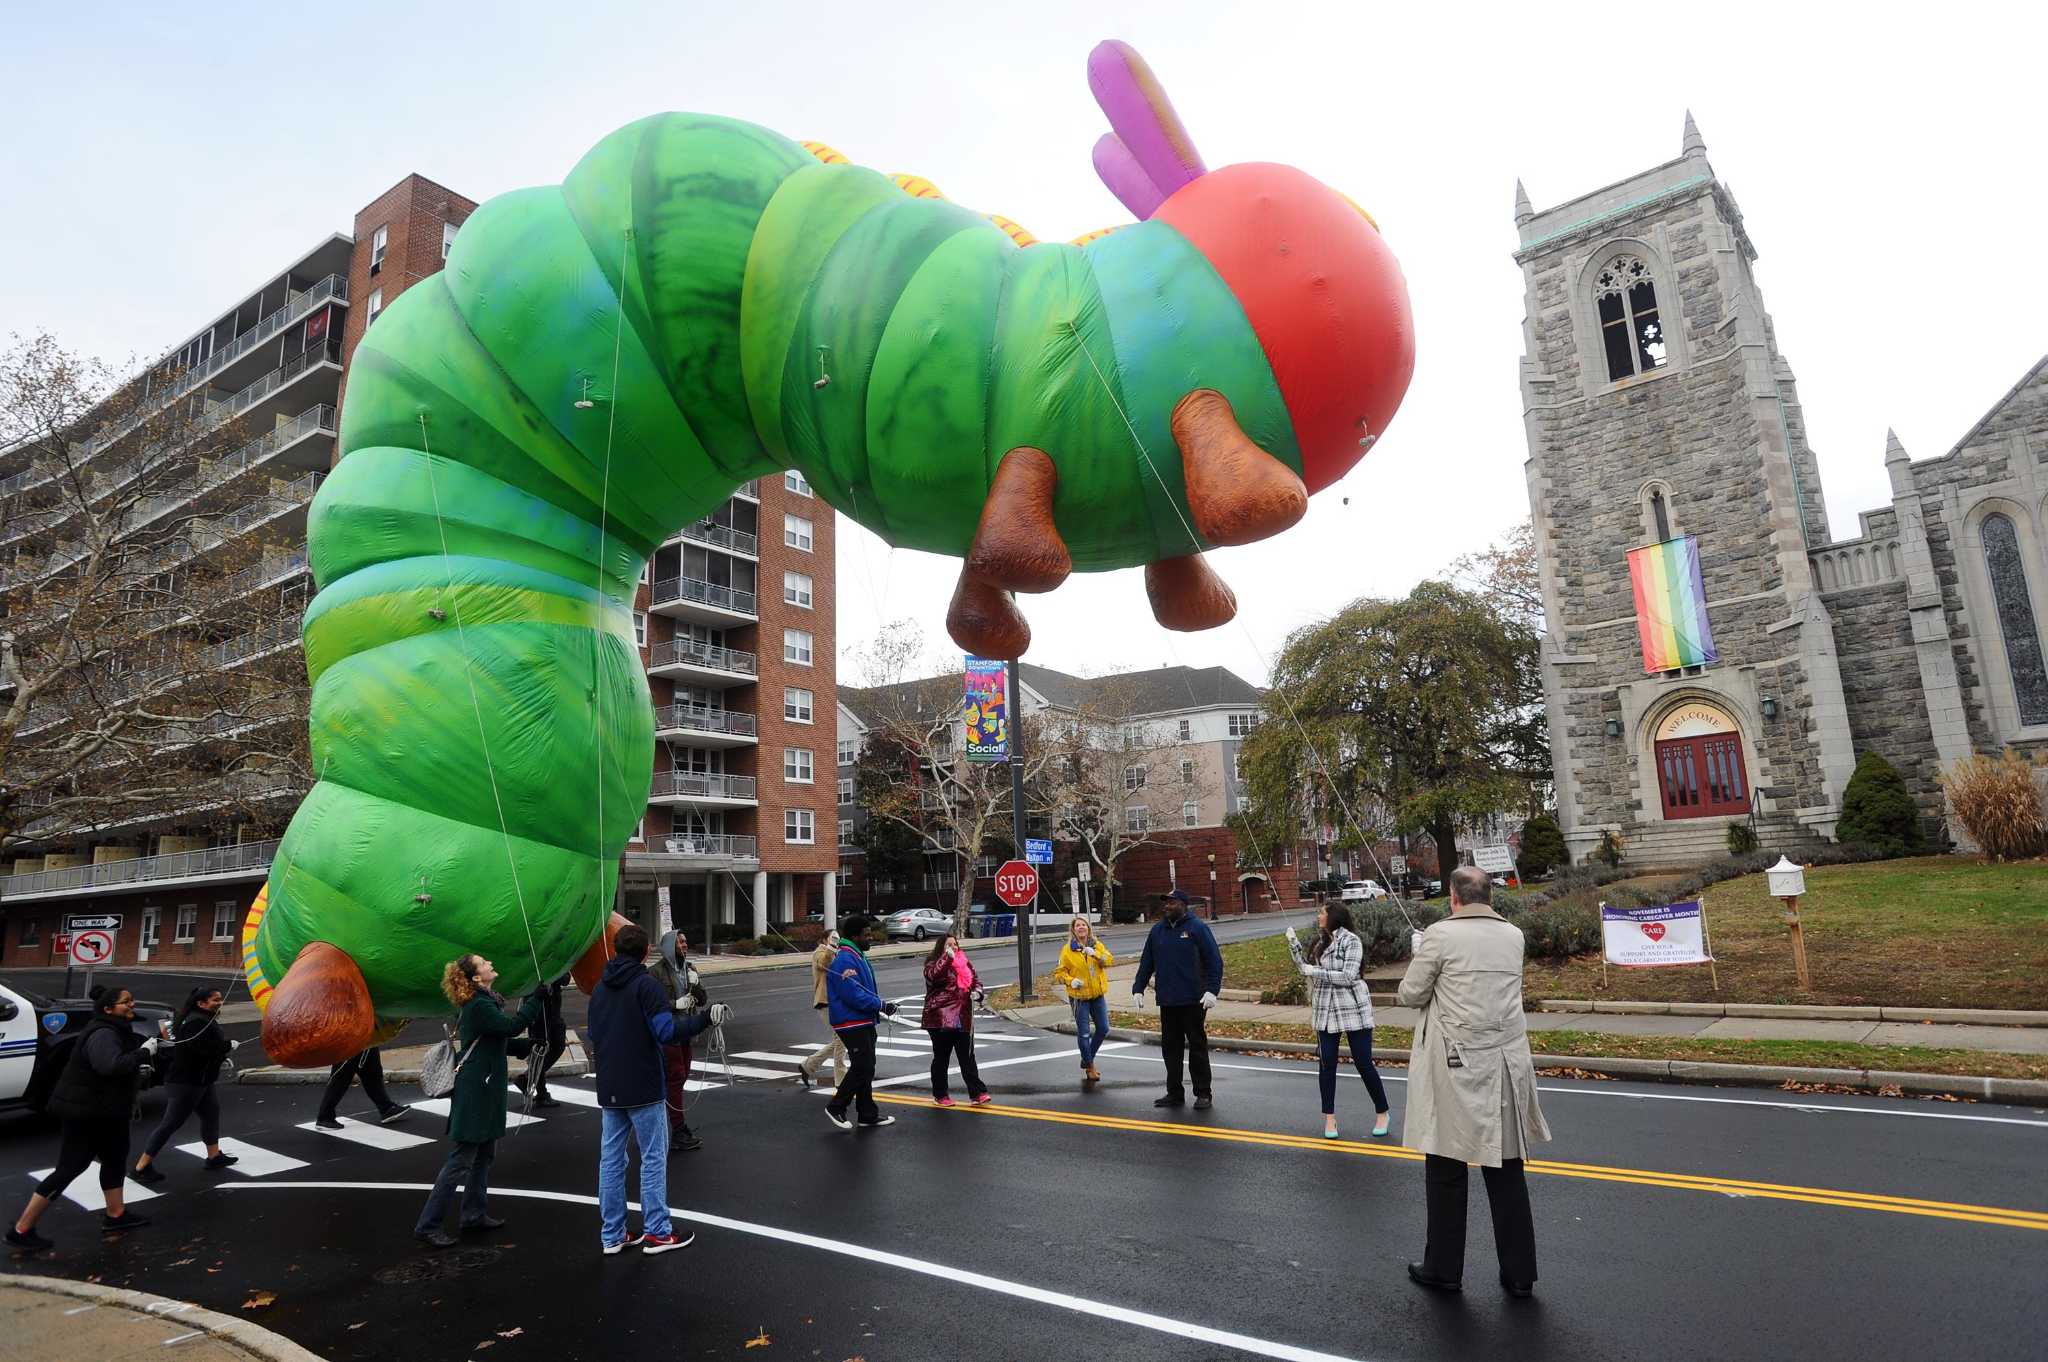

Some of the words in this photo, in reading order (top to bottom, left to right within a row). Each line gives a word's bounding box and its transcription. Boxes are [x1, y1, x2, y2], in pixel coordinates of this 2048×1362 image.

[1668, 711, 1720, 732] WELCOME
[968, 743, 1004, 753] Social!
[1026, 841, 1047, 851] Bedford
[999, 875, 1035, 892] STOP
[1639, 913, 1674, 921] CAREGIVER
